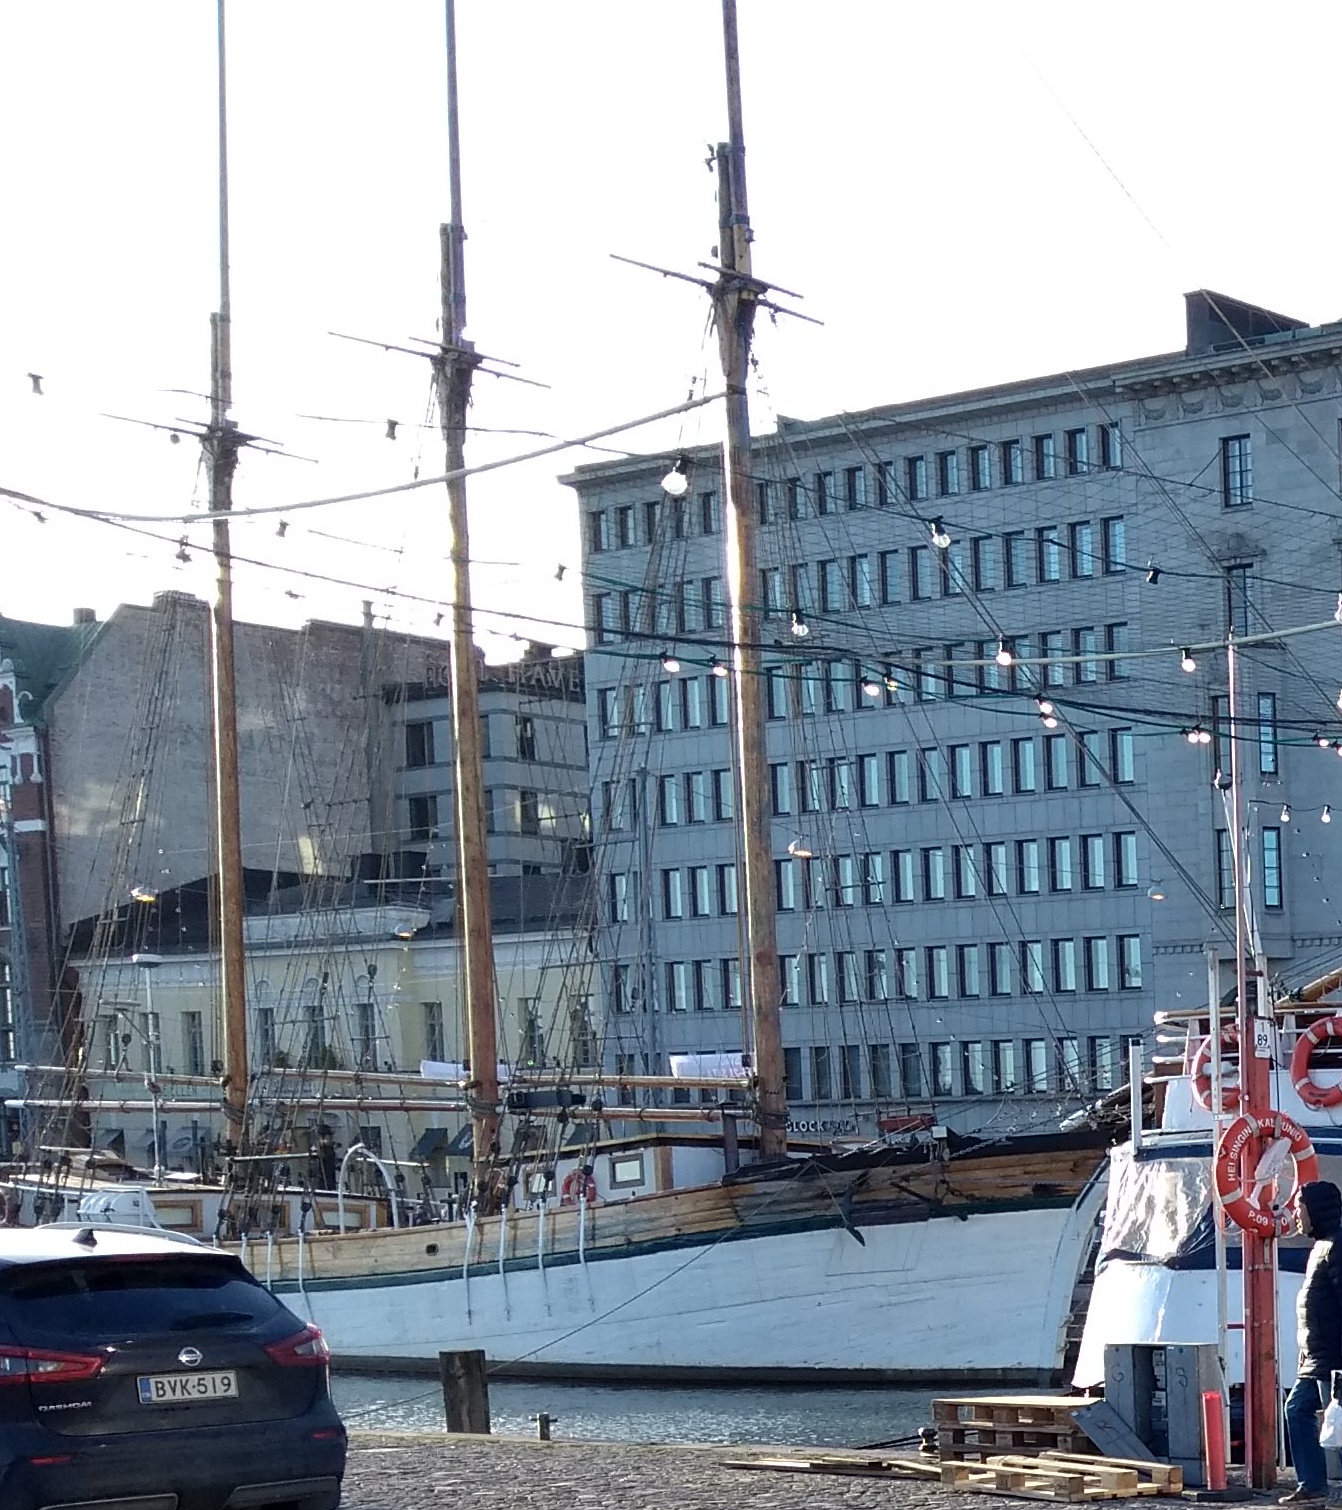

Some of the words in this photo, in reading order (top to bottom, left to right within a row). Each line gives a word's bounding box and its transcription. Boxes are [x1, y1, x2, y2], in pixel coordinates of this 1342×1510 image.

[1257, 1034, 1268, 1047] 89
[1258, 1117, 1302, 1141] KAUUNKI
[155, 1376, 232, 1399] BVK-519
